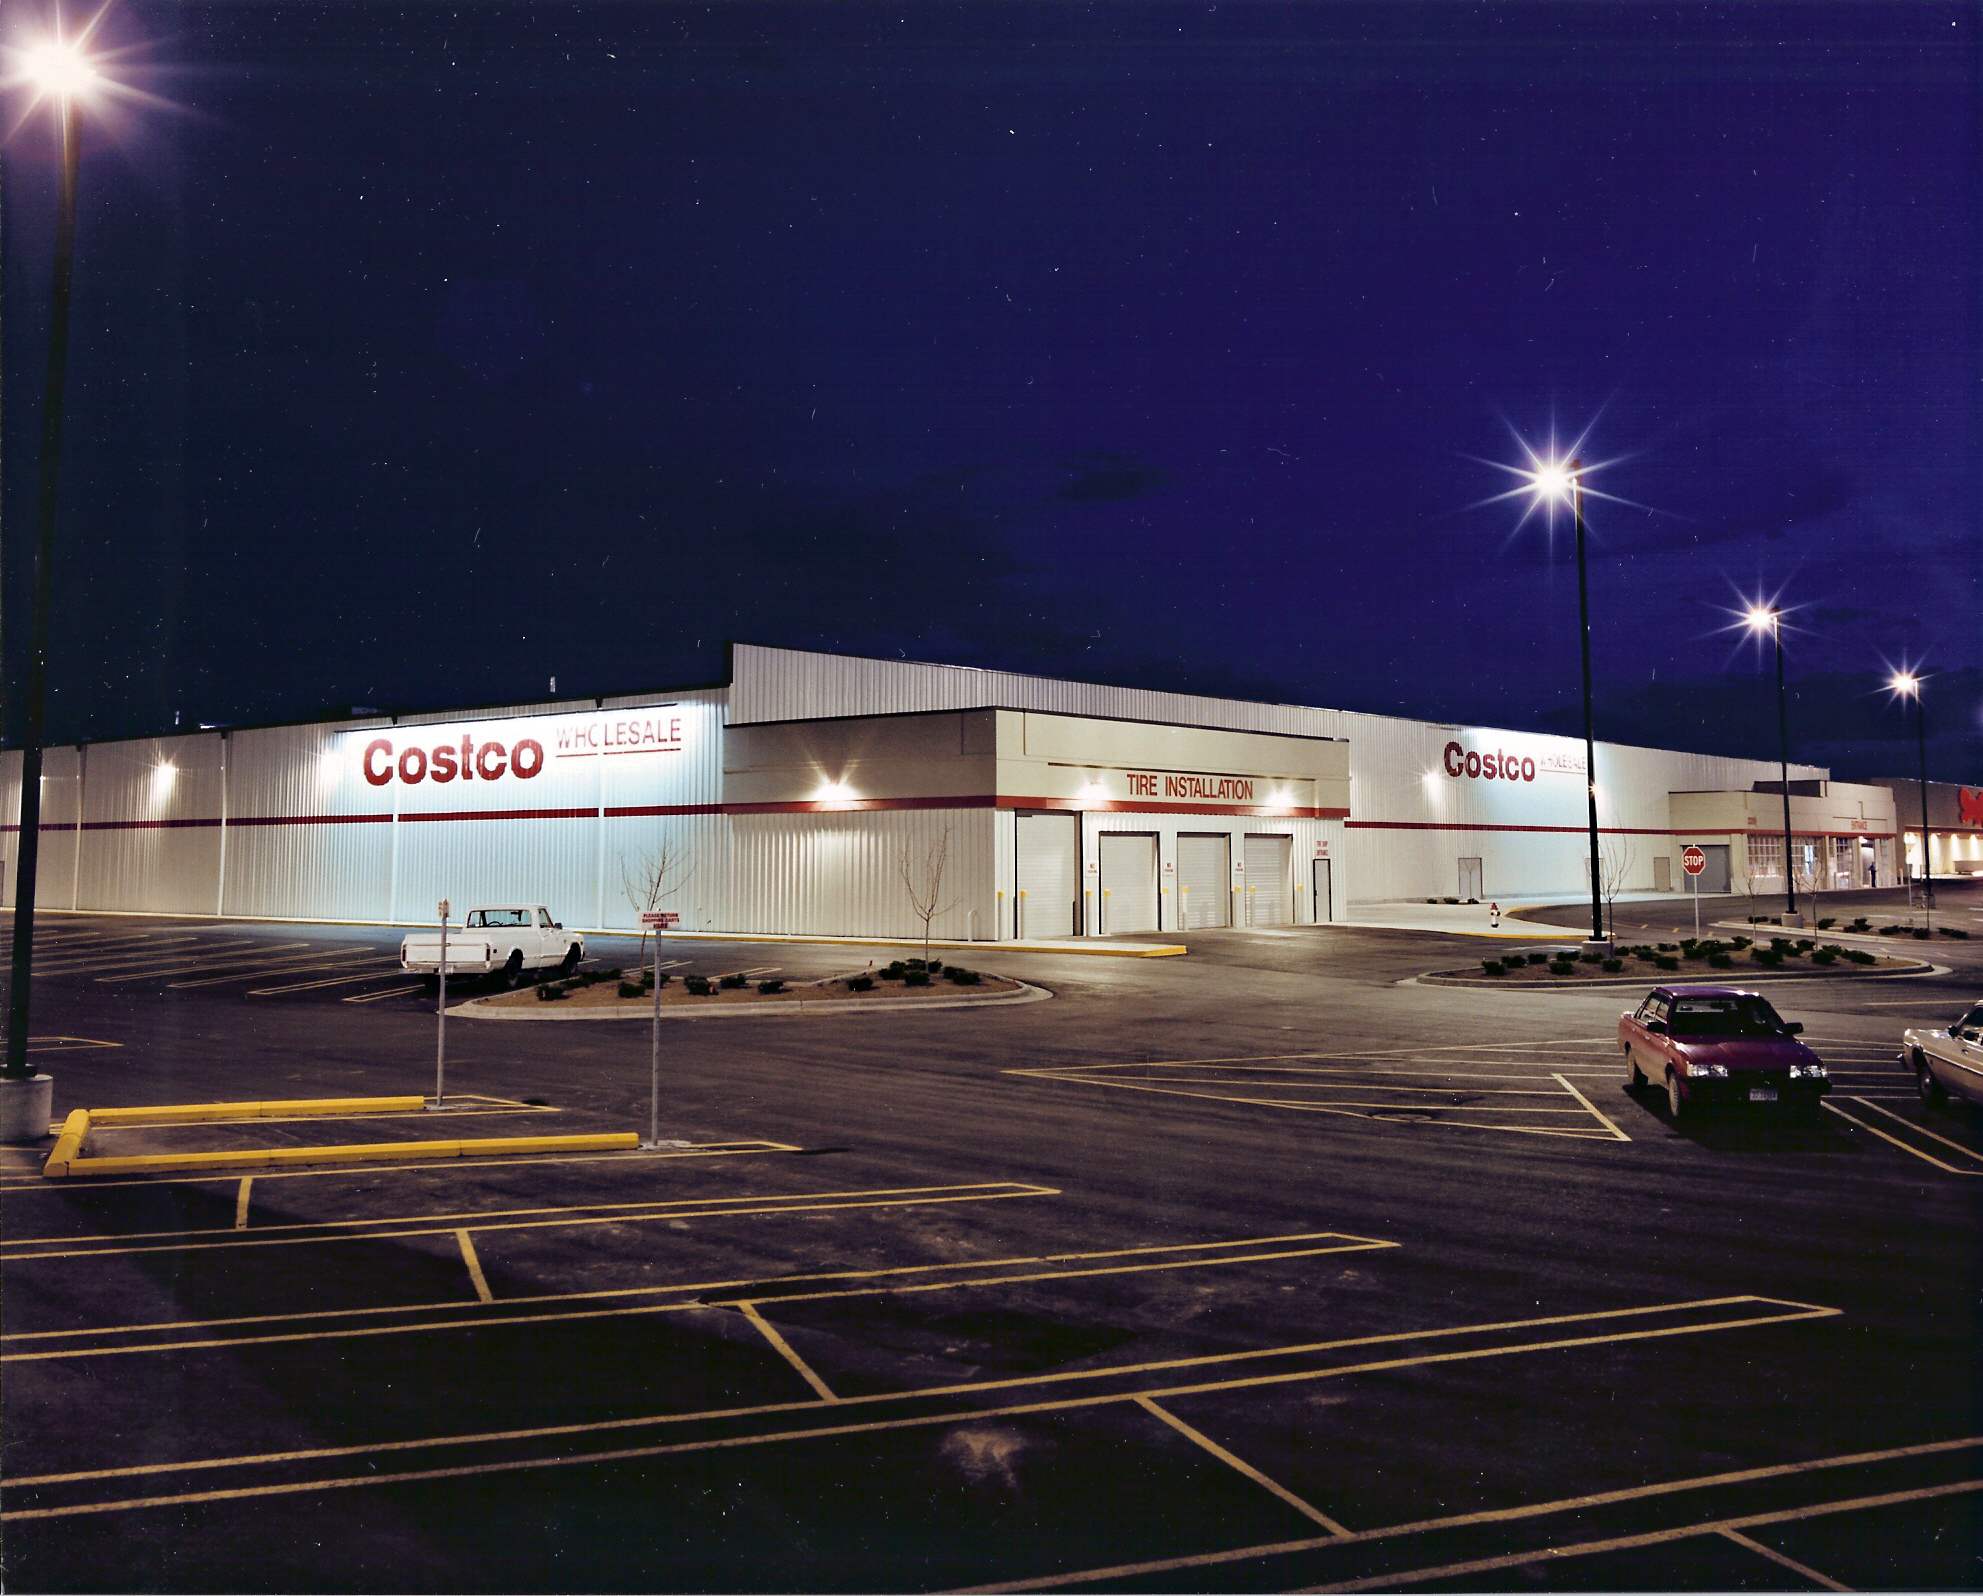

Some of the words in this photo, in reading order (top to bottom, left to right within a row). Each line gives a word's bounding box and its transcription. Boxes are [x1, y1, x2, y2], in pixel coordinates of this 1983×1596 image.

[363, 733, 545, 787] Costco
[556, 718, 682, 749] WHOLESALE
[1443, 741, 1536, 782] Costco
[1127, 773, 1158, 796] TIRE
[1165, 775, 1254, 800] INSTALLATION
[1684, 855, 1704, 866] STOP
